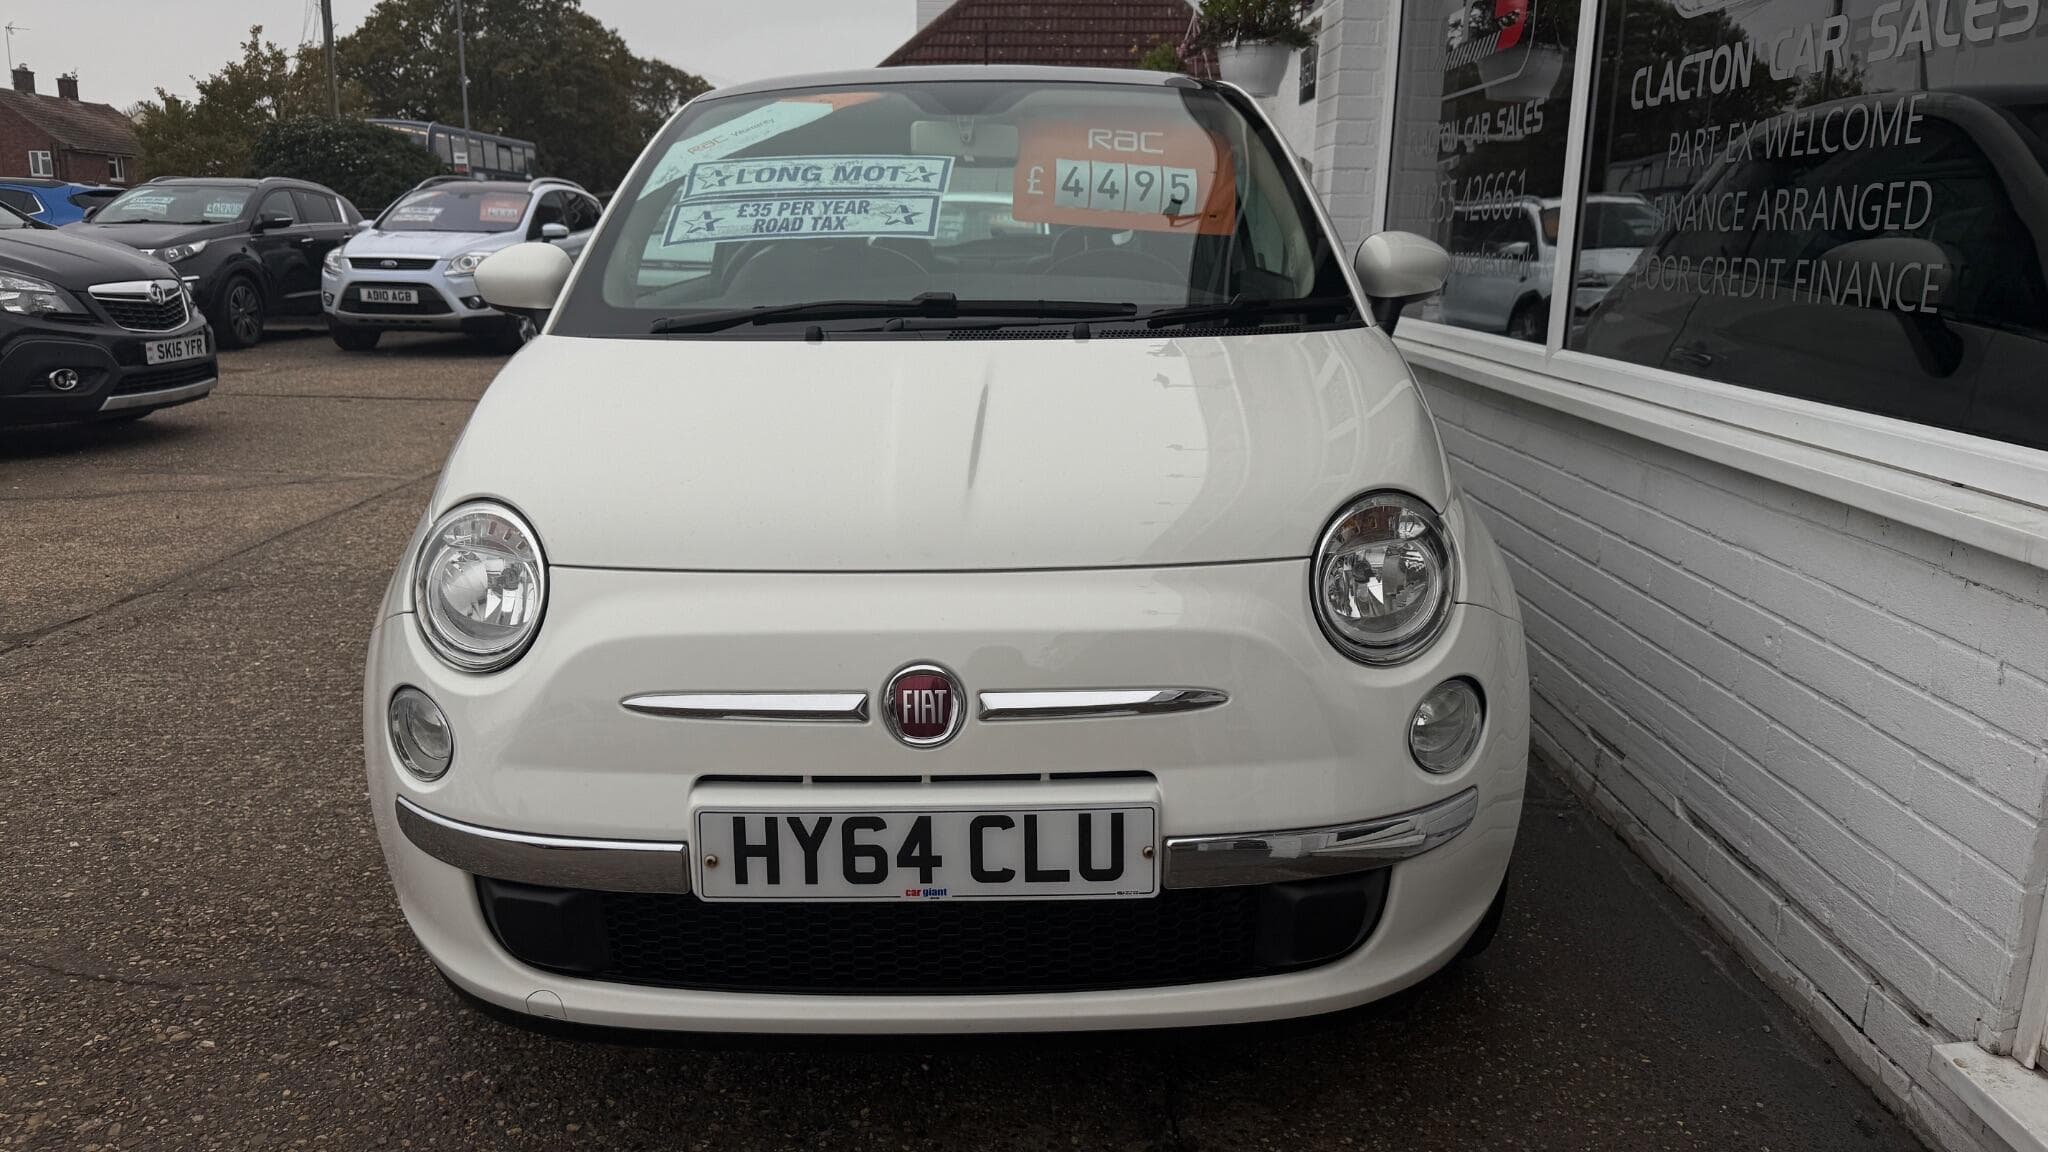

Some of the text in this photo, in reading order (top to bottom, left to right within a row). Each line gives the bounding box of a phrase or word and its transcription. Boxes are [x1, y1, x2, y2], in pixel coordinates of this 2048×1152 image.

[1631, 0, 2039, 110] CLACTON CAR SALES
[1464, 112, 1491, 144] CAR
[1497, 98, 1545, 138] SALES
[1667, 93, 1928, 169] PART EX WELCOME
[735, 164, 906, 185] LONG MOT
[1461, 168, 1526, 221] 426661
[737, 200, 871, 218] £35 PER YEAR
[752, 216, 848, 233] ROAD TAX
[1651, 180, 1933, 233] FINANCE ARRANGED
[1697, 256, 1786, 299] CREDIT
[1792, 259, 1945, 314] FINANCE
[157, 338, 202, 360] SK15 YFR
[903, 689, 947, 724] FIAT
[732, 812, 1125, 885] HY64 CLU
